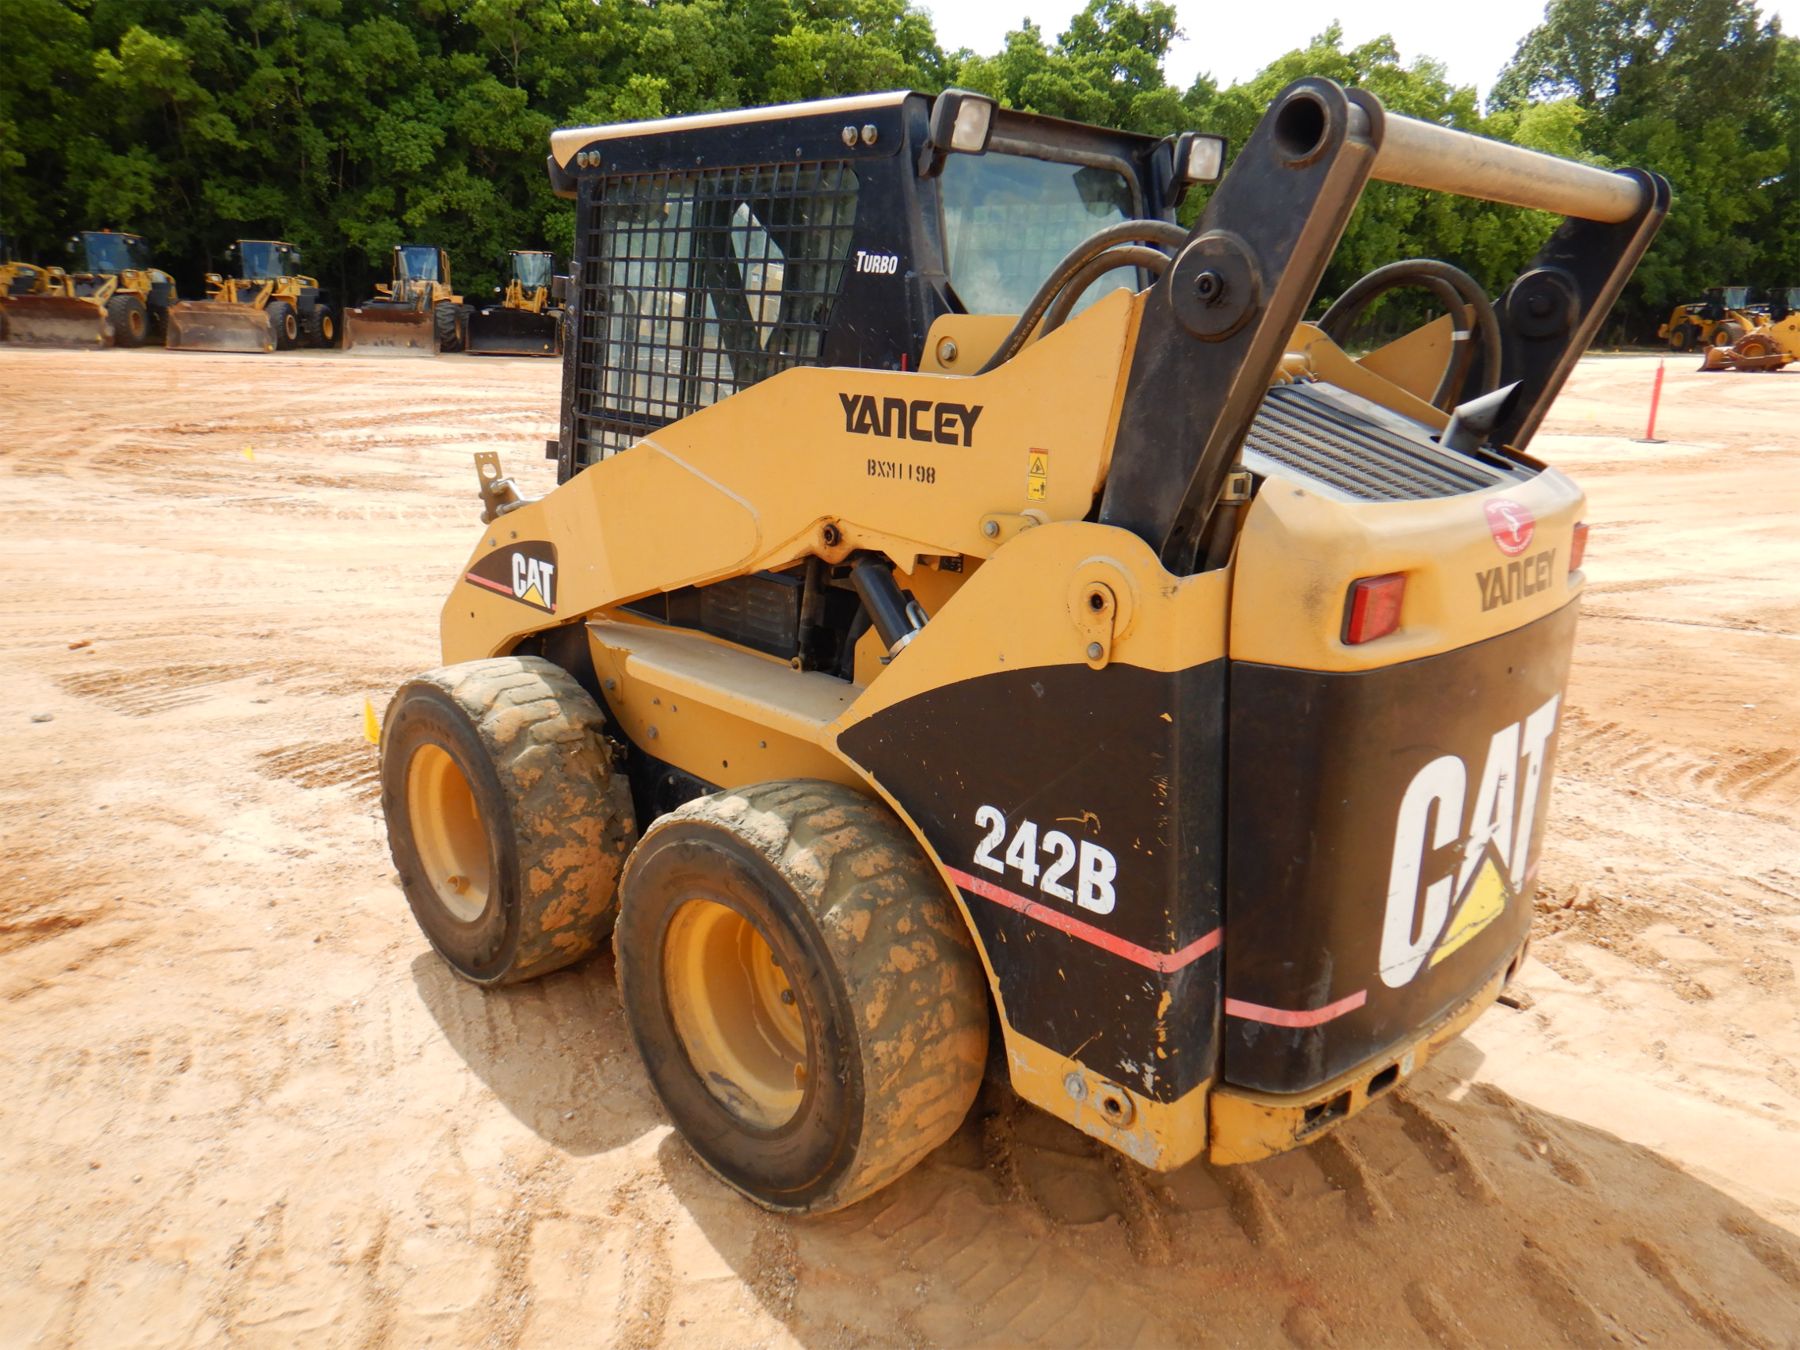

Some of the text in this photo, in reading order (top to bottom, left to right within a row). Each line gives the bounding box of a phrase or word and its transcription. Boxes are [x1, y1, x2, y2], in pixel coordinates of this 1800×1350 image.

[856, 251, 898, 275] TURBO
[838, 392, 984, 448] YANCEY
[512, 552, 554, 609] CAT
[1475, 547, 1556, 613] YANCEY
[973, 805, 1117, 915] 242B
[1378, 692, 1562, 989] CAT
